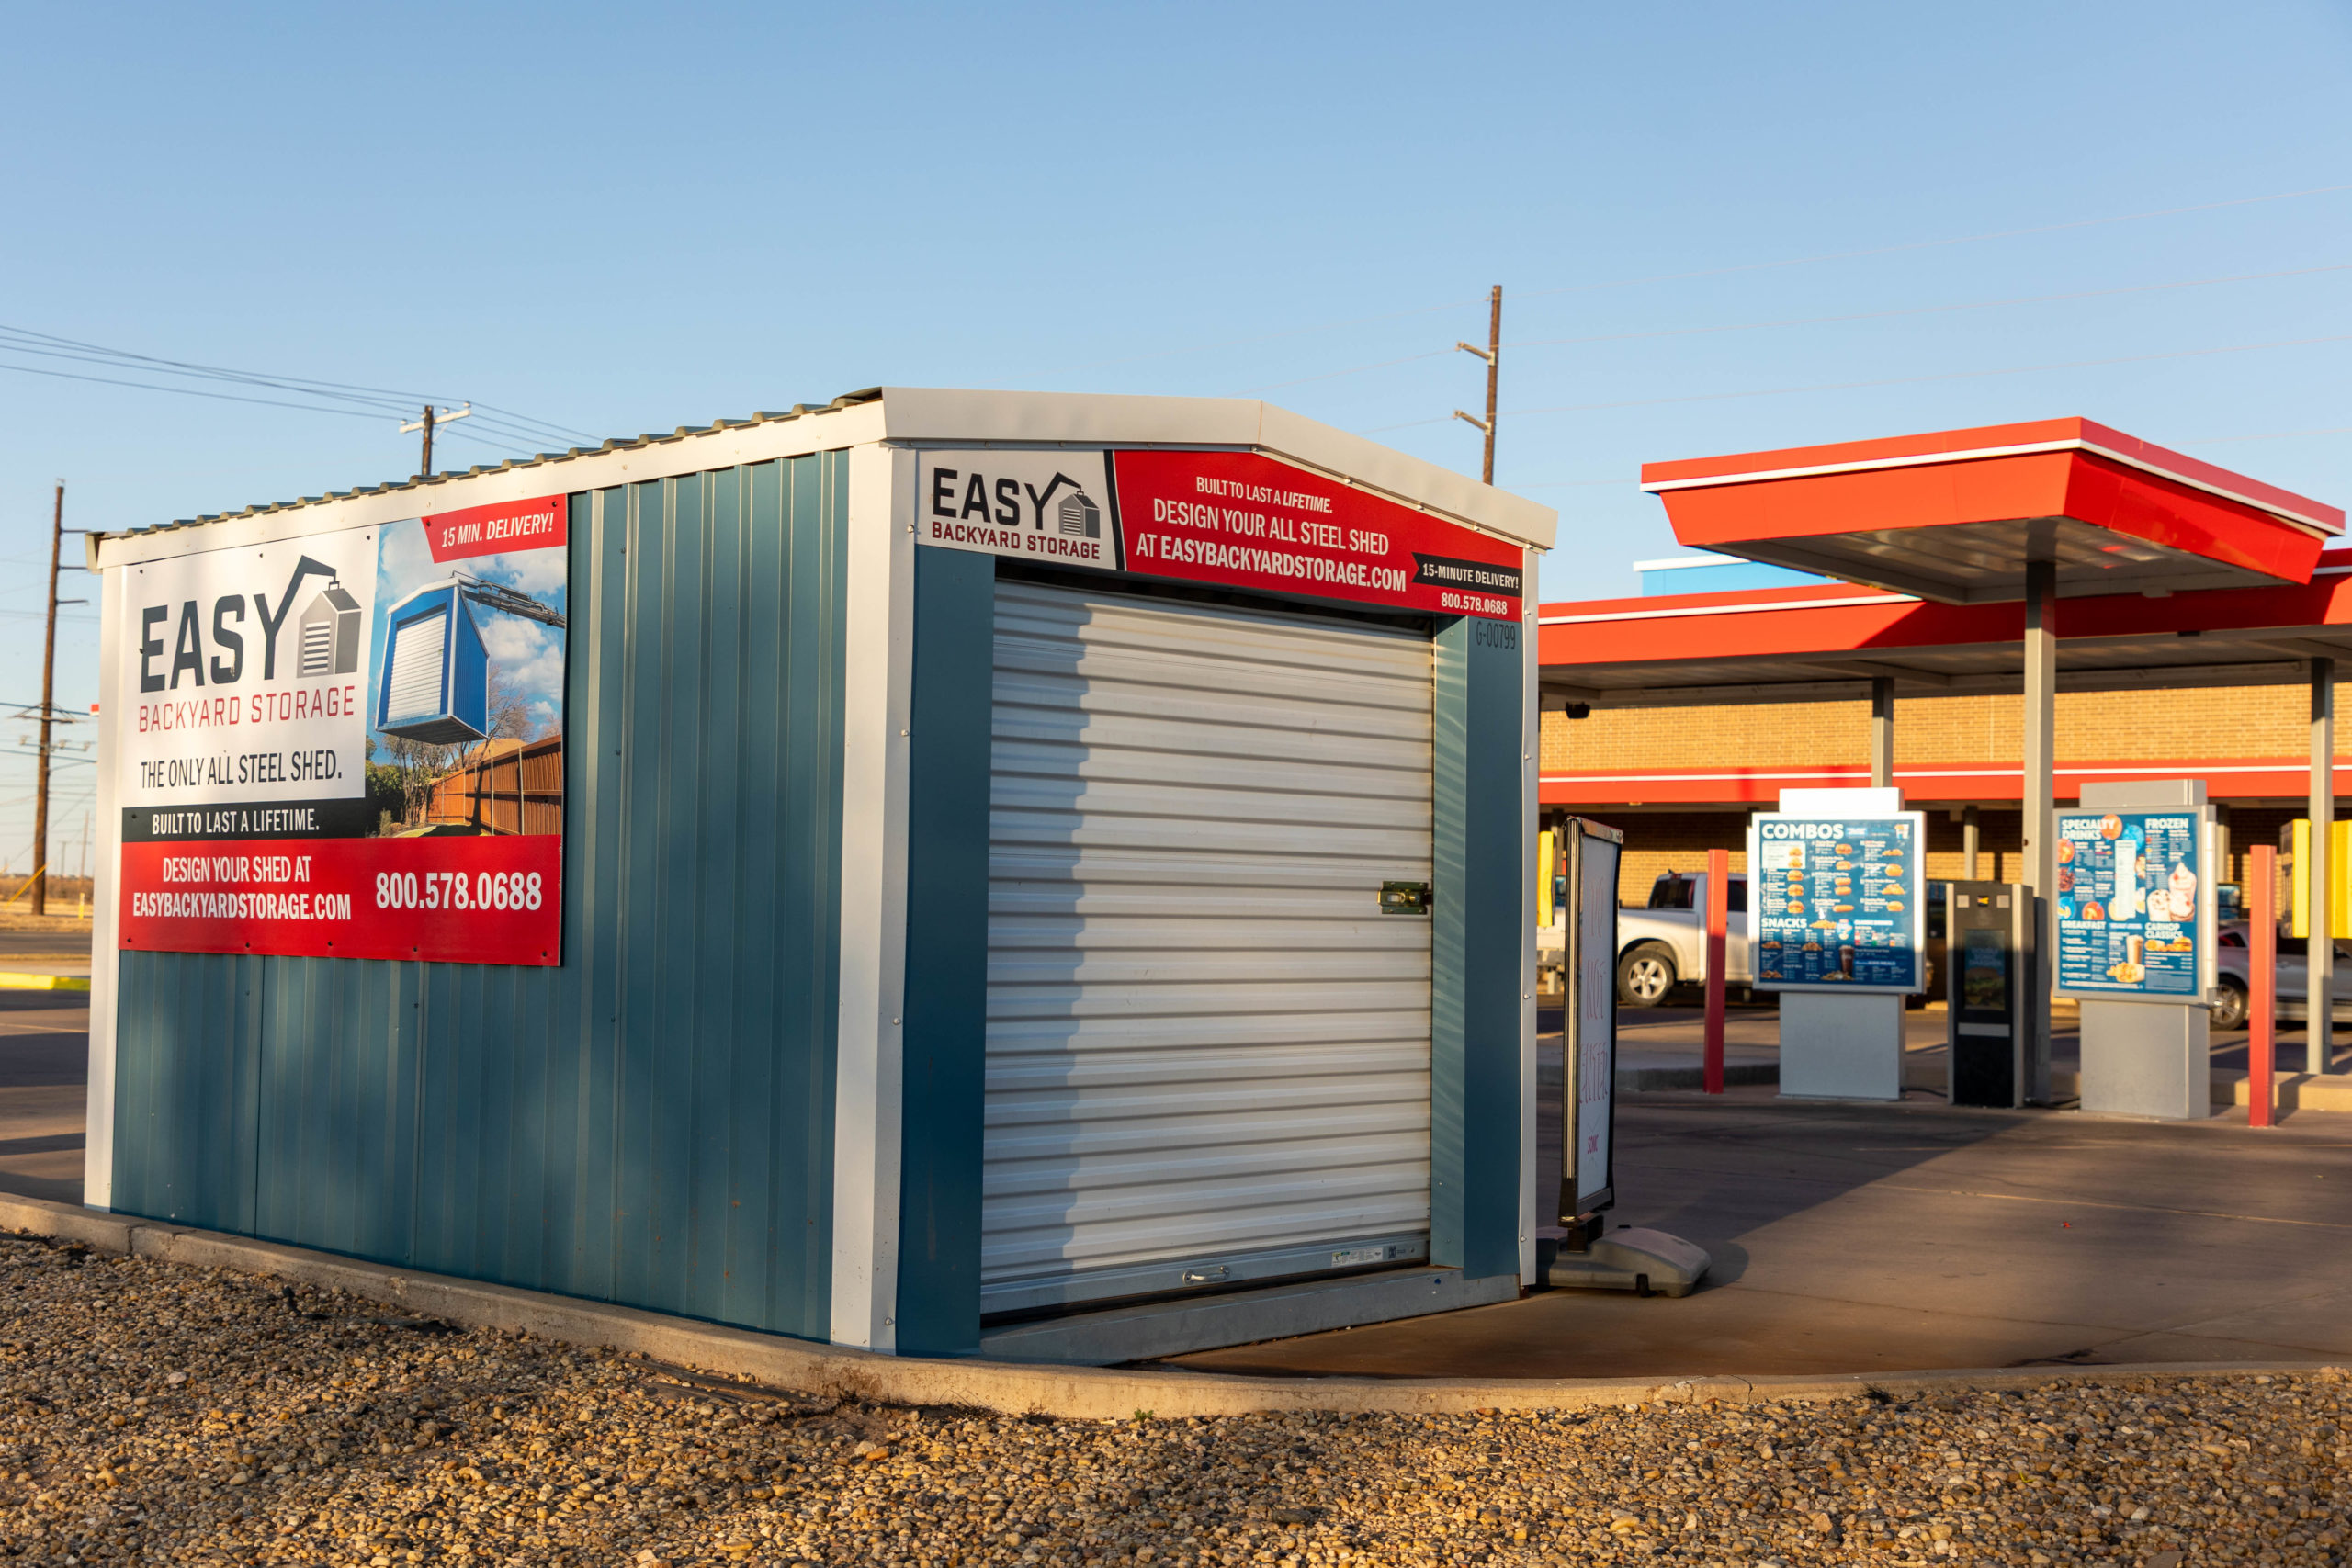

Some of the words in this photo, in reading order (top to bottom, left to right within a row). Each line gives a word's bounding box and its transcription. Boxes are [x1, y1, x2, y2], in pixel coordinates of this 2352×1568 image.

[933, 467, 1070, 531] EASY
[1196, 476, 1227, 496] BUILT
[1229, 481, 1244, 499] TO
[1246, 484, 1272, 503] LAST
[1273, 490, 1282, 505] A
[1283, 491, 1333, 513] LIFETIME.
[442, 527, 456, 547] 15
[458, 523, 482, 545] MIN.
[486, 513, 554, 540] DELIVERY!
[932, 521, 1021, 549] BACKYARD
[1027, 535, 1101, 560] STORAGE
[1154, 498, 1219, 531] DESIGN
[1222, 508, 1266, 537] YOUR
[1269, 516, 1297, 543] ALL
[1300, 521, 1346, 549] STEEL
[1349, 528, 1389, 556] SHED
[1136, 532, 1158, 558] AT
[1160, 536, 1407, 592] EASYBACKYARDSTORAGE.COM
[1422, 563, 1474, 582] 15-MINUTE
[1475, 570, 1519, 589] DELIVERY!
[1441, 592, 1508, 615] 800.578.0688
[141, 555, 312, 693] EASY
[1476, 620, 1516, 650] G-00799
[139, 696, 241, 733] BACKYARD
[251, 685, 356, 724] STORAGE
[141, 761, 165, 789] THE
[168, 757, 204, 787] ONLY
[207, 755, 233, 785] ALL
[238, 752, 286, 784] STEEL
[290, 750, 342, 781] SHED.
[152, 813, 185, 835] BUILT
[187, 812, 202, 834] TO
[206, 811, 237, 833] LAST
[240, 810, 249, 832] A
[253, 808, 320, 832] LIFETIME.
[1761, 823, 1845, 840] COMBOS
[2062, 818, 2116, 830] SPECIALTY
[2062, 829, 2102, 840] DRINKS
[2145, 818, 2188, 829] FROZEN
[163, 857, 210, 882] DESIGN
[212, 856, 250, 882] YOUR
[253, 856, 291, 882] SHED
[294, 856, 311, 882] AT
[376, 872, 542, 910] 800.578.0688
[133, 892, 351, 920] EASYBACKYARDSTORAGE.COM
[1761, 918, 1807, 928] SNACKS
[2061, 920, 2107, 930] BREAKFAST
